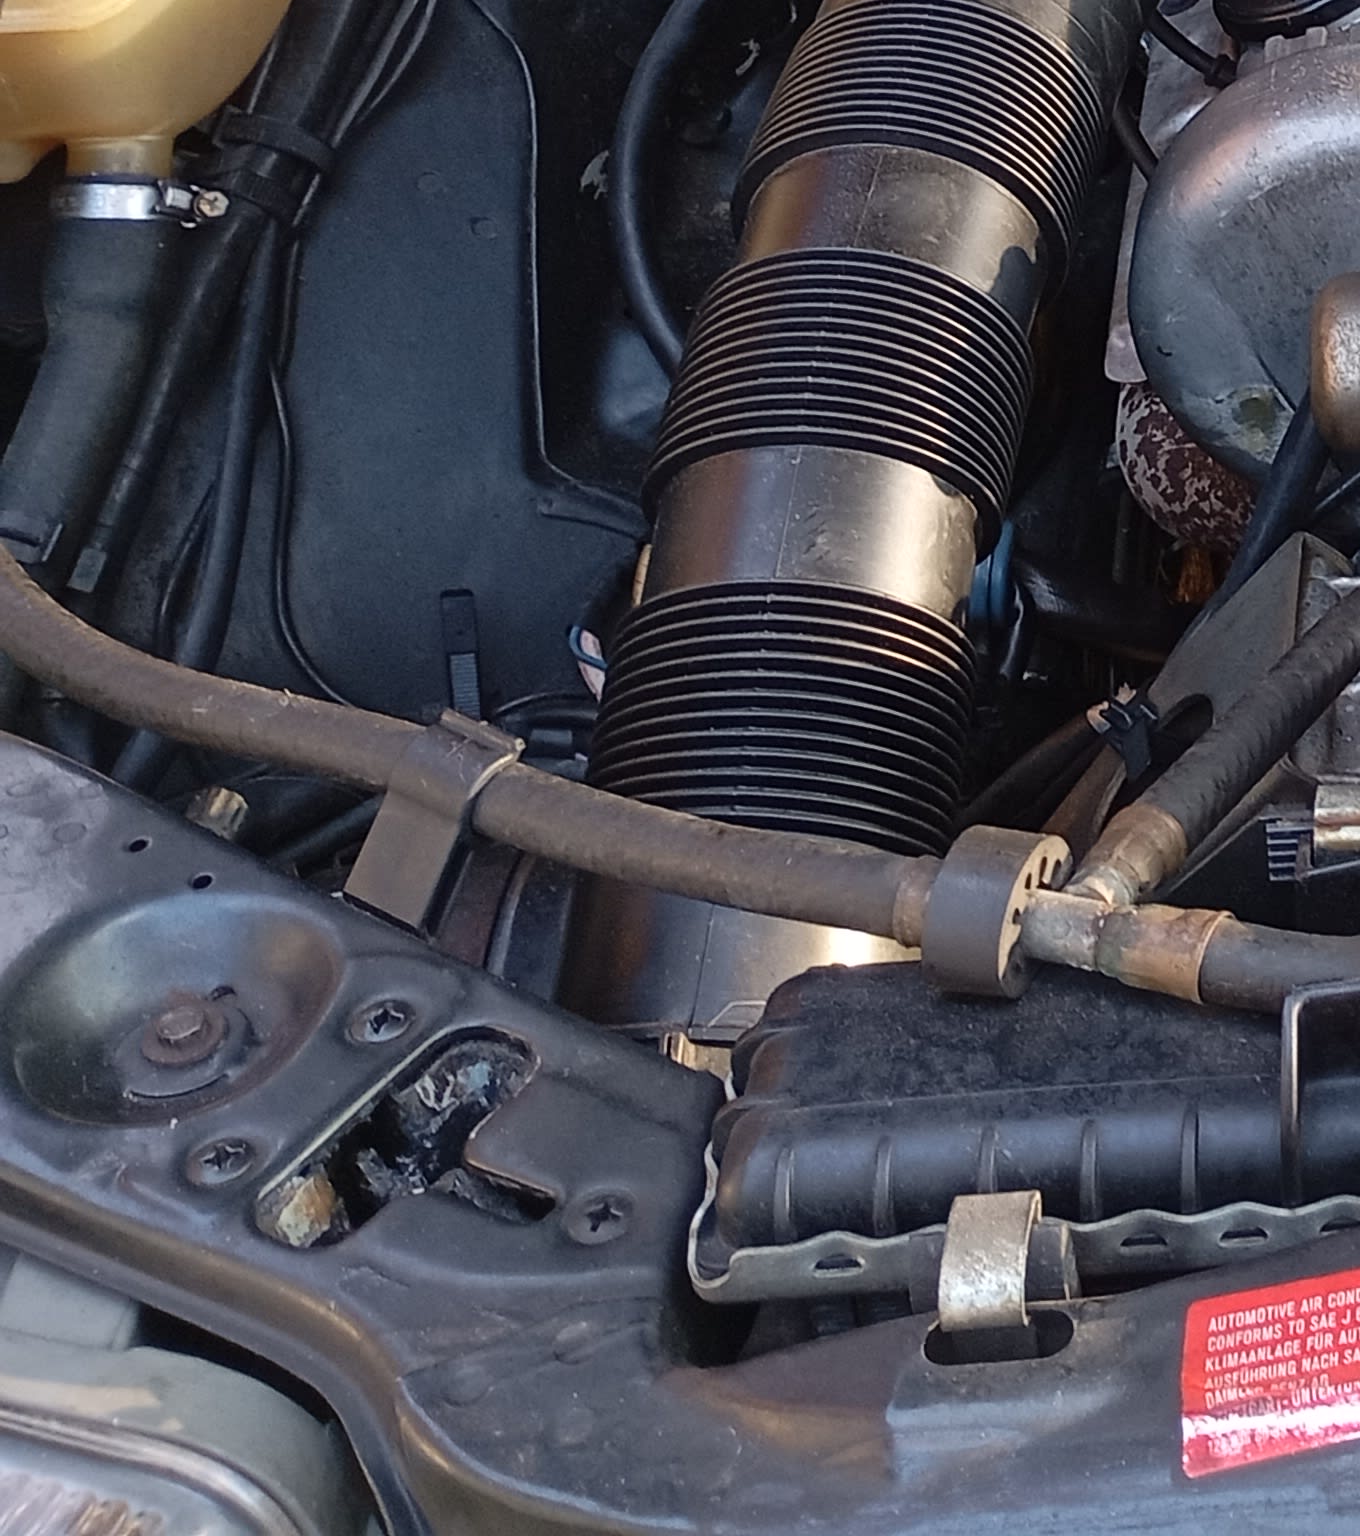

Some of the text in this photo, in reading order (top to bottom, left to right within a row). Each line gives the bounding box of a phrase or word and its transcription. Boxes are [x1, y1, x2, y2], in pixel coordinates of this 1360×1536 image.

[1207, 1325, 1283, 1352] CONFORMS
[1288, 1317, 1306, 1334] TO
[1310, 1311, 1337, 1332] SAE
[1341, 1309, 1349, 1325] J
[1208, 1302, 1296, 1333] AUTOMOTIVE
[1300, 1295, 1324, 1314] AIR
[1205, 1340, 1301, 1372] KLIMAANLAGE
[1306, 1330, 1333, 1351] FÜR
[1204, 1361, 1297, 1390] AUSFÜHRUNG
[1301, 1353, 1338, 1373] NACH
